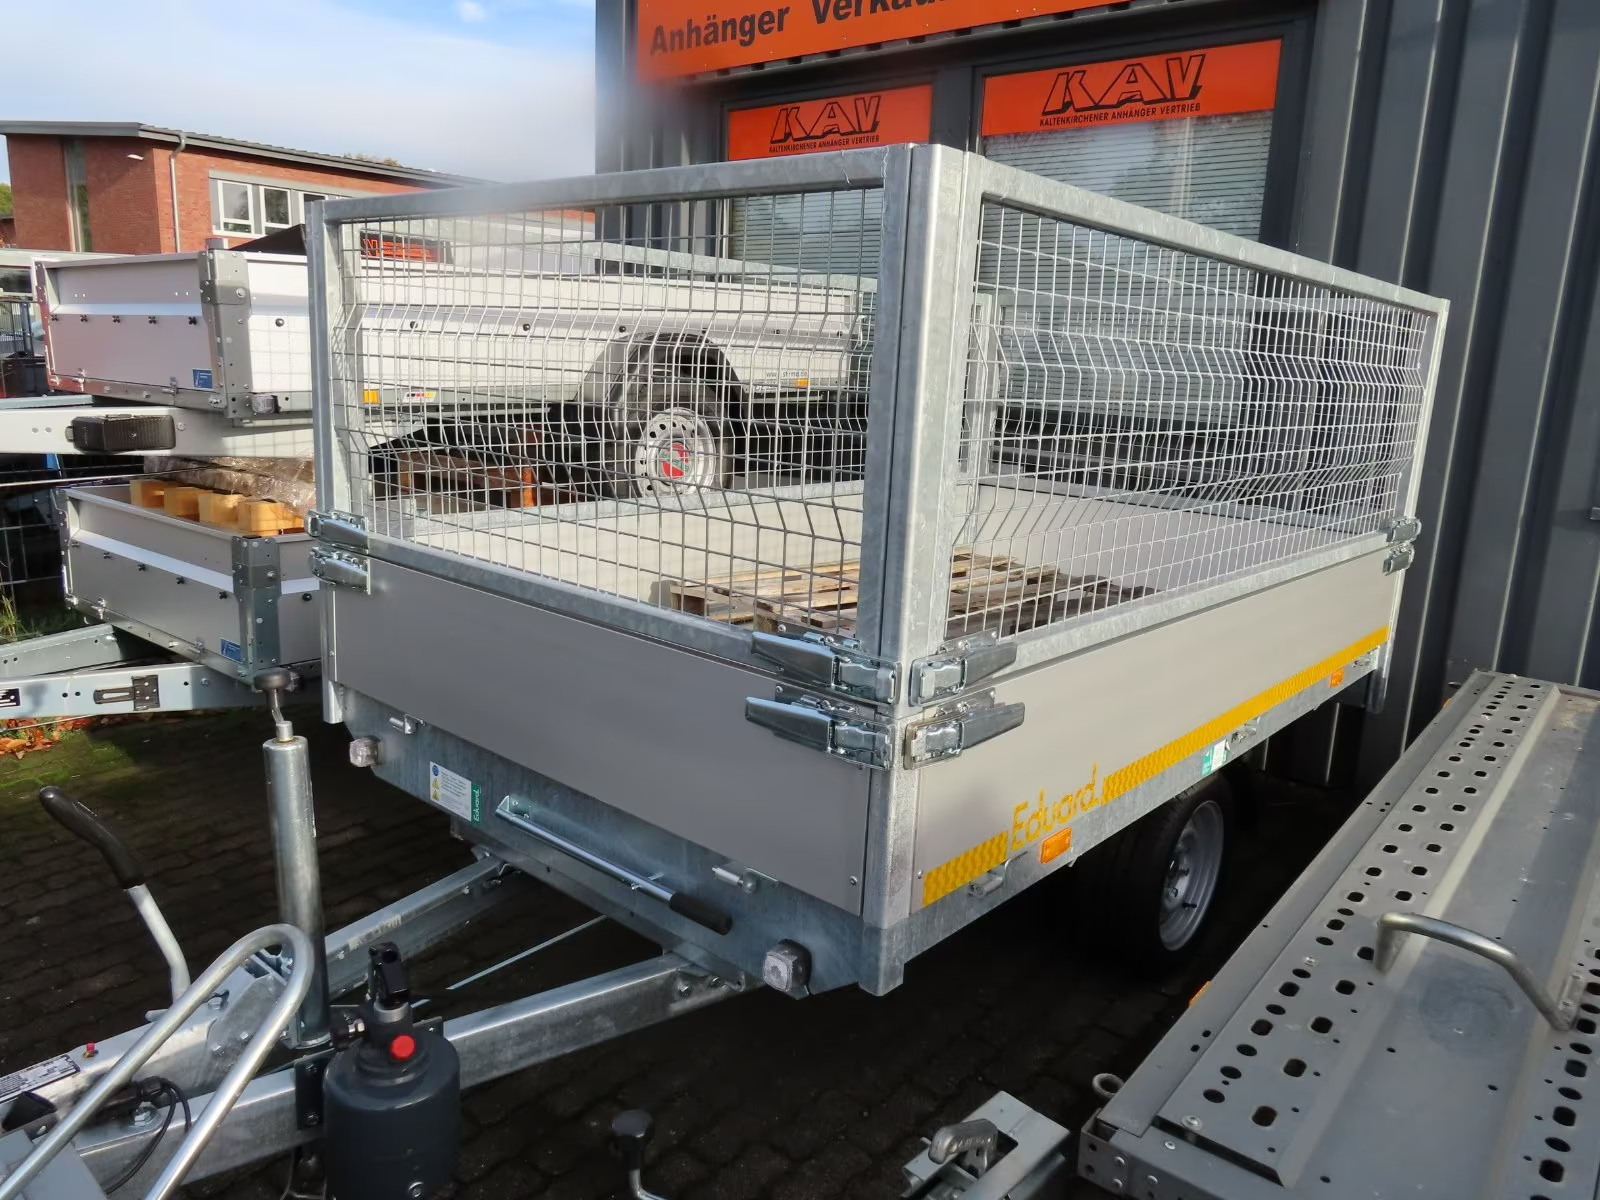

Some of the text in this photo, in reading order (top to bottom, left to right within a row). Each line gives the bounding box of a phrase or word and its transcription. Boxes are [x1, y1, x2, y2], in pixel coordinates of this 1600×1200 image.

[651, 0, 935, 55] Anhänger Verka
[1041, 53, 1206, 116] KAV
[770, 95, 881, 144] KAV
[1039, 102, 1201, 127] KALTENKIRCHENER ANHÄNGER VERTRIEB
[768, 135, 880, 153] KALTENKIRCHENER ANHÄNGER VERTRIEB
[1011, 760, 1099, 852] Eduard
